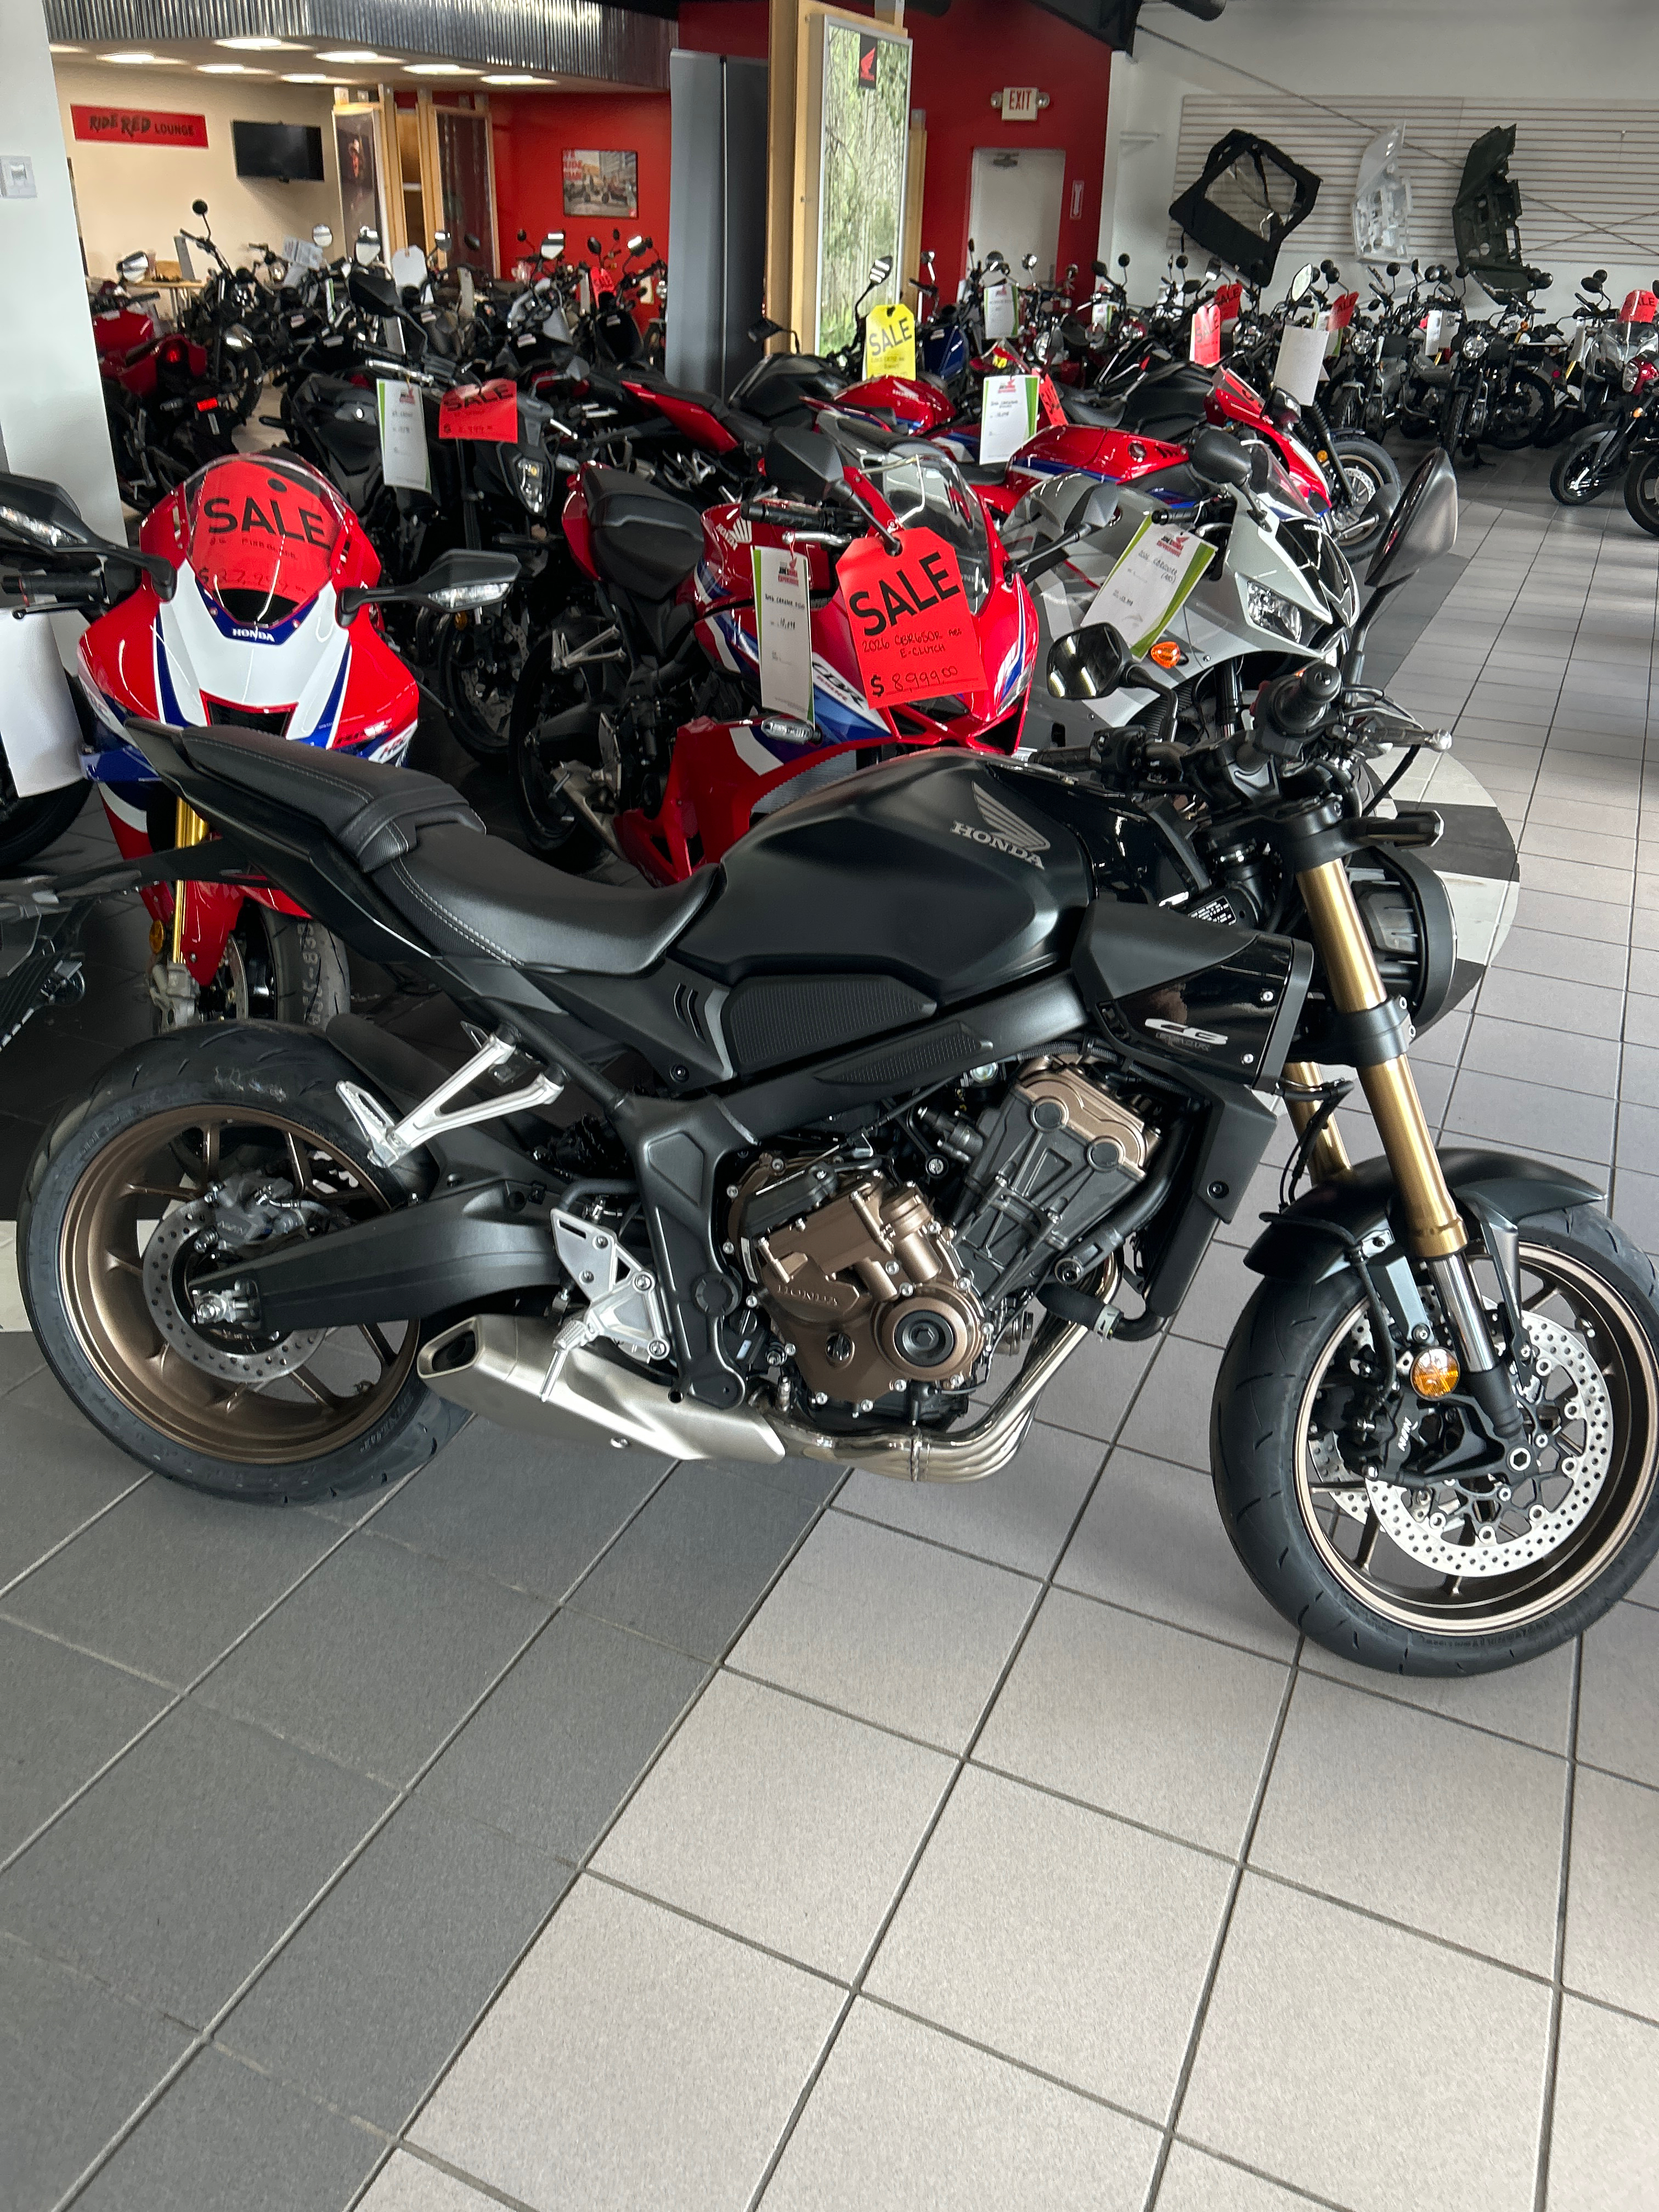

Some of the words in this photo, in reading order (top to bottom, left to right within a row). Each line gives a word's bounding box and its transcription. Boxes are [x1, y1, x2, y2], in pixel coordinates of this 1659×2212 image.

[1009, 90, 1031, 111] EXIT
[89, 114, 118, 132] RIDE
[121, 115, 151, 137] RED
[154, 123, 195, 136] LOUNGE
[868, 317, 912, 356] SALE
[1195, 312, 1219, 343] SALE
[204, 497, 331, 550] SALE
[715, 522, 738, 552] HONDA
[849, 550, 961, 636] SALE
[232, 628, 275, 642] HONDA
[862, 637, 890, 653] 2026
[900, 644, 946, 658] E-CLUTCH
[870, 674, 885, 697] $
[950, 820, 1045, 870] HONDA
[777, 1284, 838, 1307] HONDA
